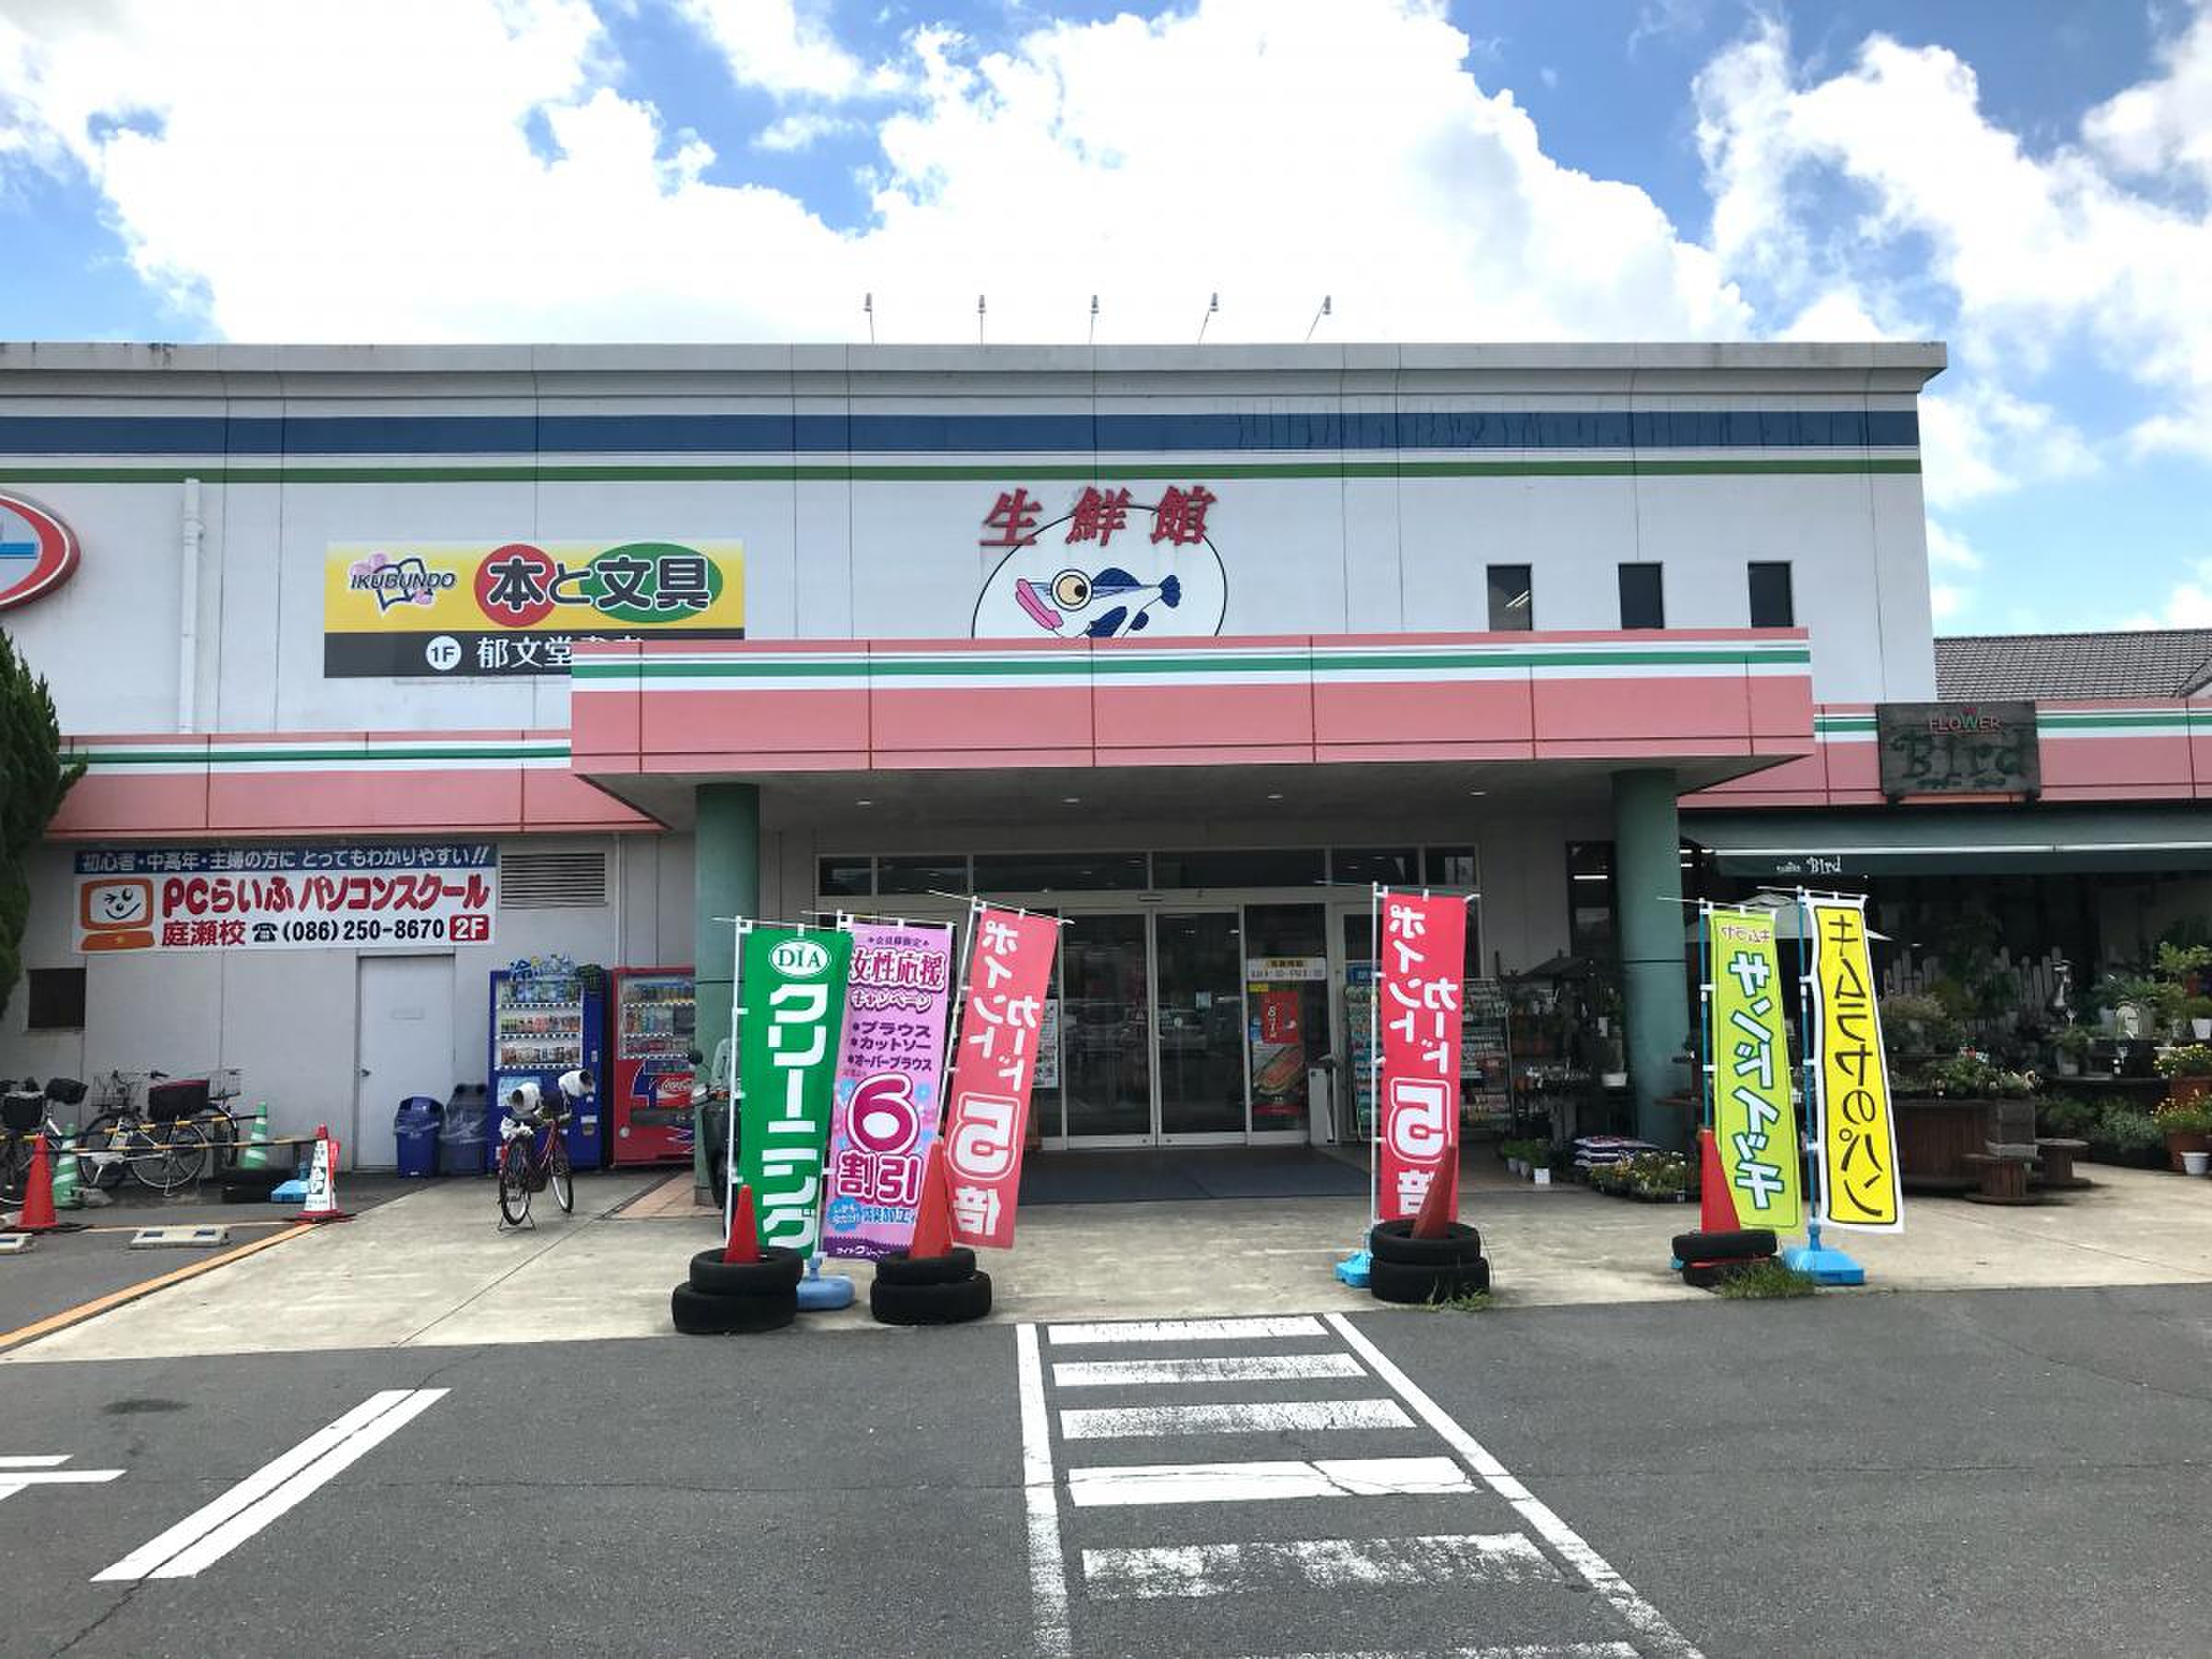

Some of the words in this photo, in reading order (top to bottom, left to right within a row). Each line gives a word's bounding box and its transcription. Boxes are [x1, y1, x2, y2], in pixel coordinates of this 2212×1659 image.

[980, 486, 1218, 547] 生鮮館
[350, 571, 456, 590] IKUBUNDO
[487, 555, 711, 610] 本と文具
[431, 645, 455, 663] 1F
[1929, 715, 2002, 733] FLOWER
[161, 921, 246, 947] 庭瀬校
[454, 918, 486, 939] 2F
[777, 947, 822, 969] DIA
[860, 1037, 932, 1052] カットソー
[761, 983, 829, 1249] クリーニング
[850, 1075, 916, 1152] 6
[840, 1152, 920, 1202] 割引
